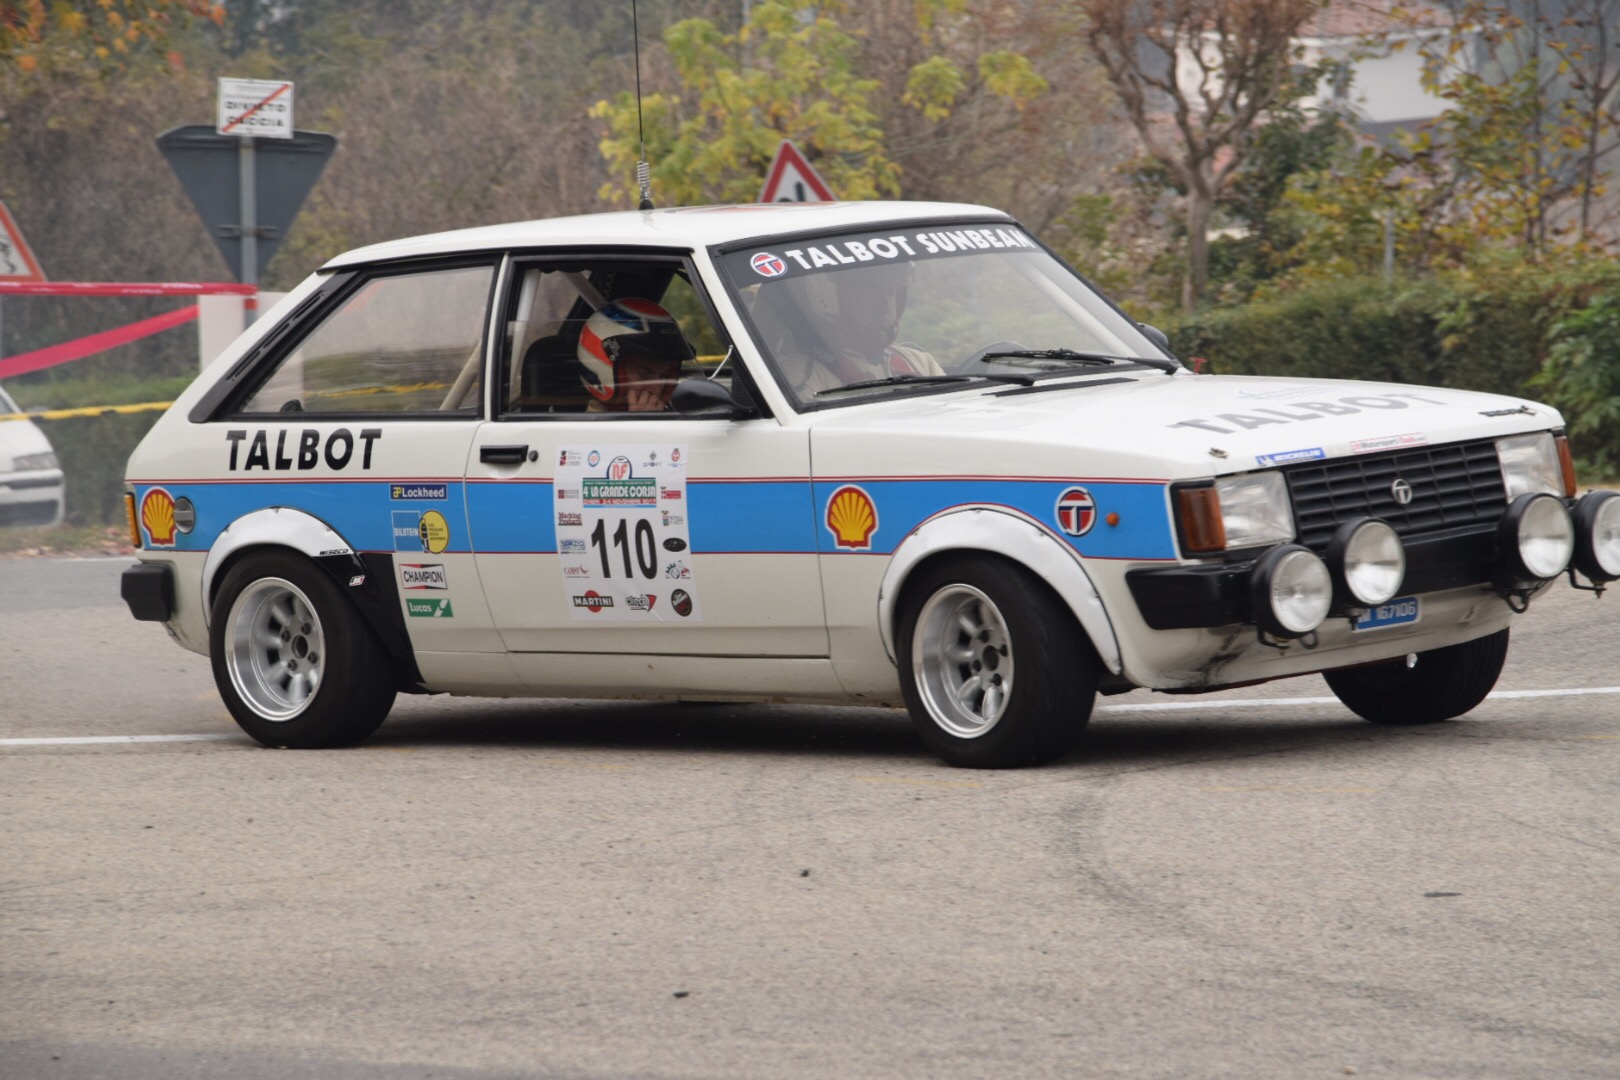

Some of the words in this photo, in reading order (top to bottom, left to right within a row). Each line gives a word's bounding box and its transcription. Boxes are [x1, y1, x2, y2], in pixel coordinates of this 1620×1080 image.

[785, 236, 915, 270] TALBOT
[915, 229, 1037, 254] SUNBEAM
[1169, 393, 1449, 434] TALBOT
[226, 428, 382, 471] TALBOT
[402, 487, 445, 498] Lockheed
[600, 486, 628, 498] GRANDE
[629, 486, 656, 498] CORSA
[394, 528, 419, 537] BILSTEIN
[591, 518, 658, 580] 110
[403, 571, 443, 583] CHAMPION
[409, 602, 432, 612] Lucas
[575, 597, 613, 607] MARTINI
[1376, 602, 1416, 620] 167106
